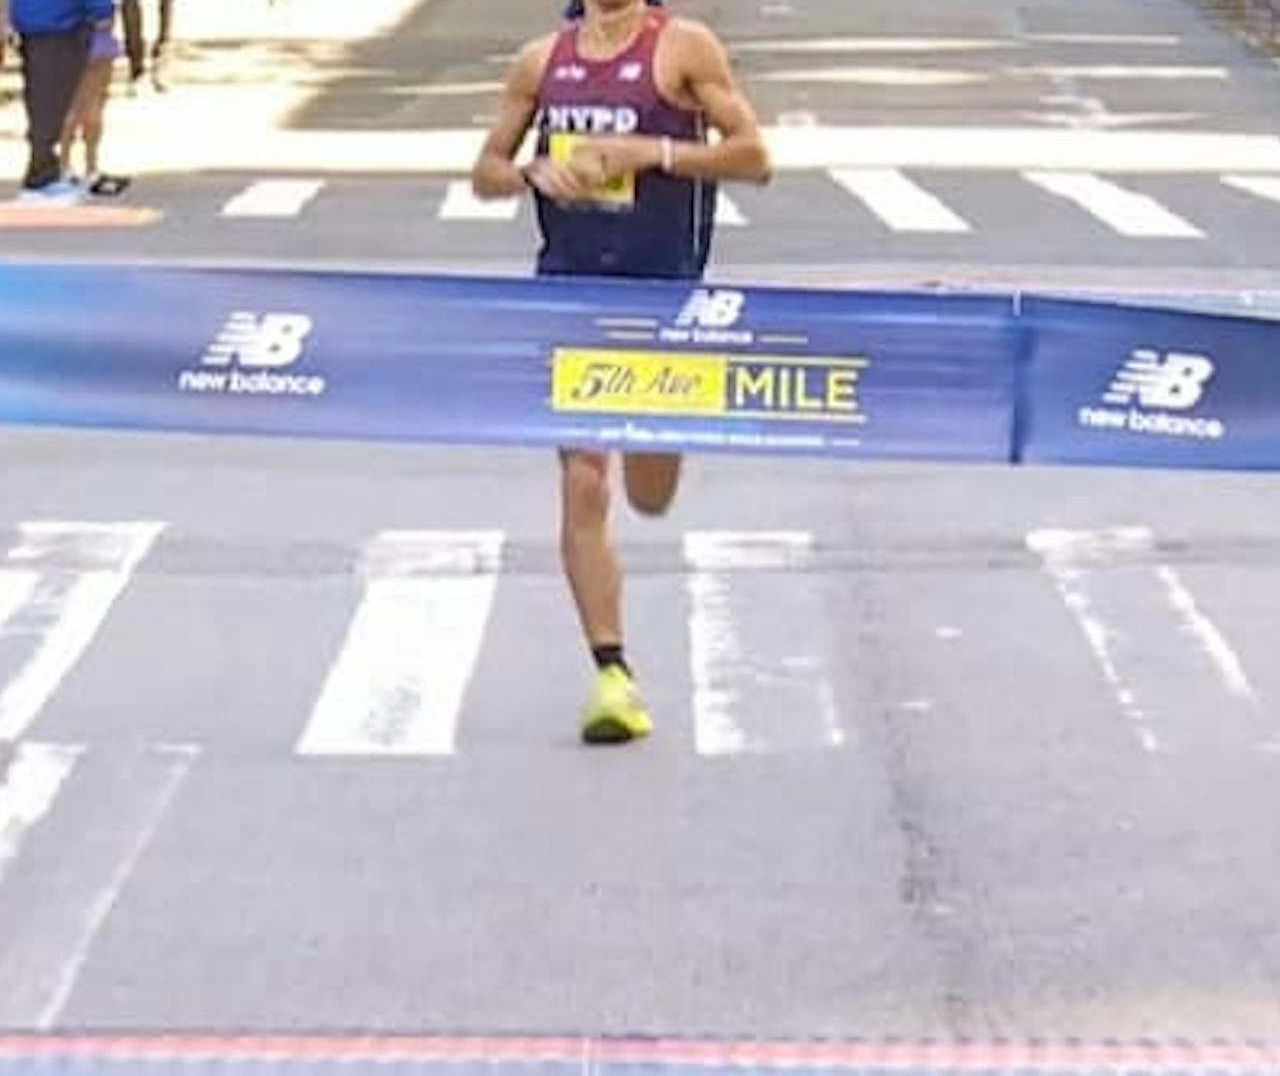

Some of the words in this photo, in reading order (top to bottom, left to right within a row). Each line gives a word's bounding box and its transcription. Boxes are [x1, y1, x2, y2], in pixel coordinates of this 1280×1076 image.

[548, 106, 638, 134] NYPD
[204, 311, 313, 364] NB
[180, 371, 226, 391] new
[229, 371, 324, 395] balance
[734, 366, 859, 410] MILE
[1103, 349, 1214, 409] NB
[1079, 407, 1128, 428] new
[1129, 407, 1225, 439] balance
